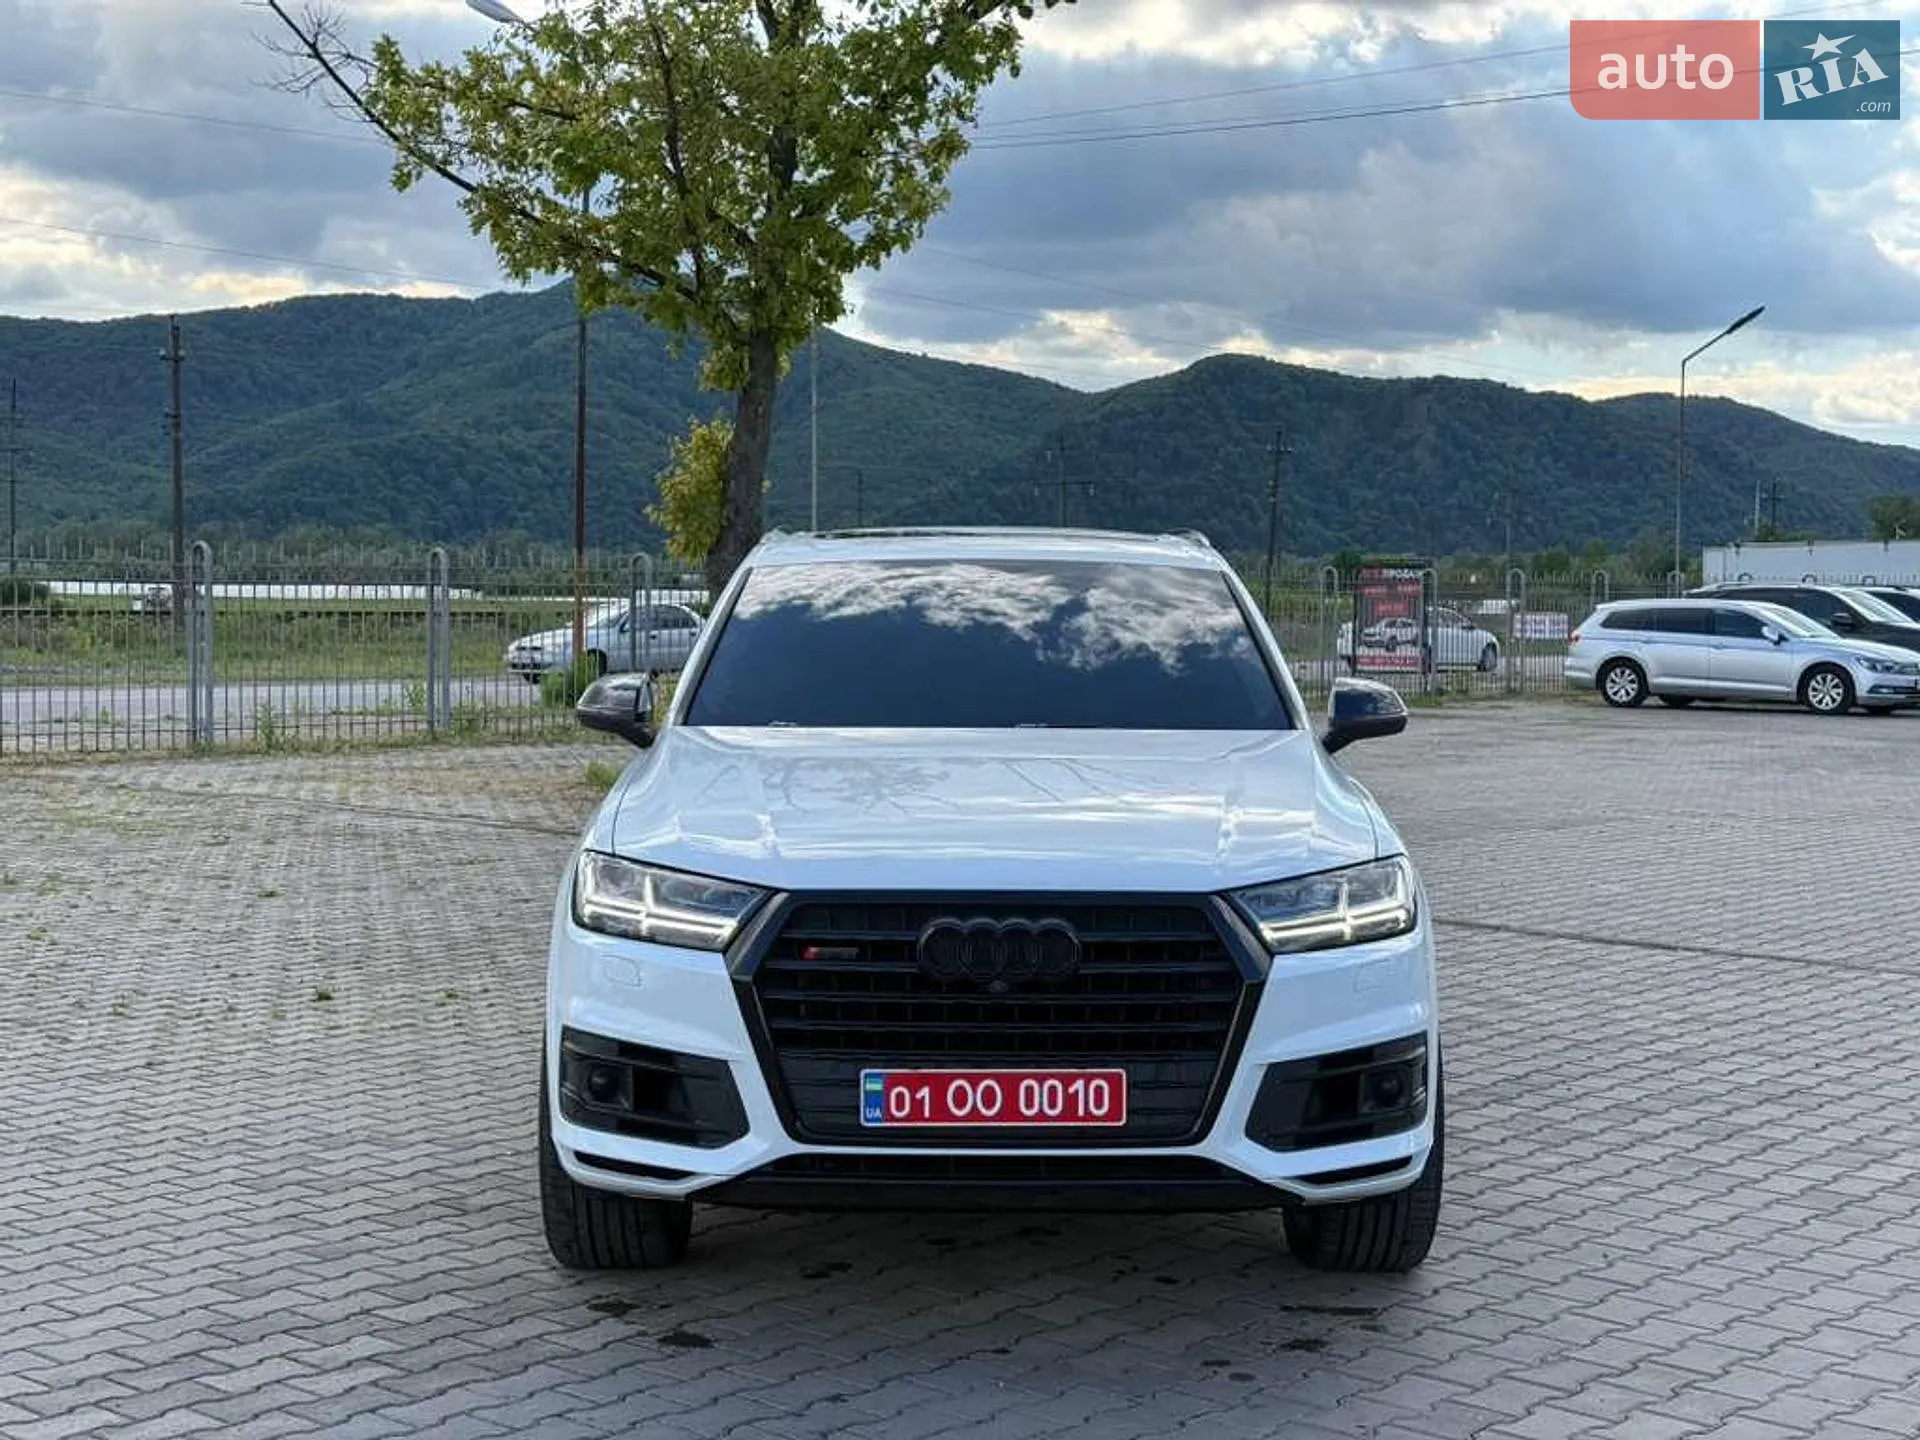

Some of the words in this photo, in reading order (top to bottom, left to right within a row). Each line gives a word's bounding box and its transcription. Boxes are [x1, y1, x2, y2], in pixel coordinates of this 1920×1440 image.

[890, 1085, 930, 1118] 01
[1019, 1079, 1110, 1117] 0010
[866, 1106, 882, 1119] UA
